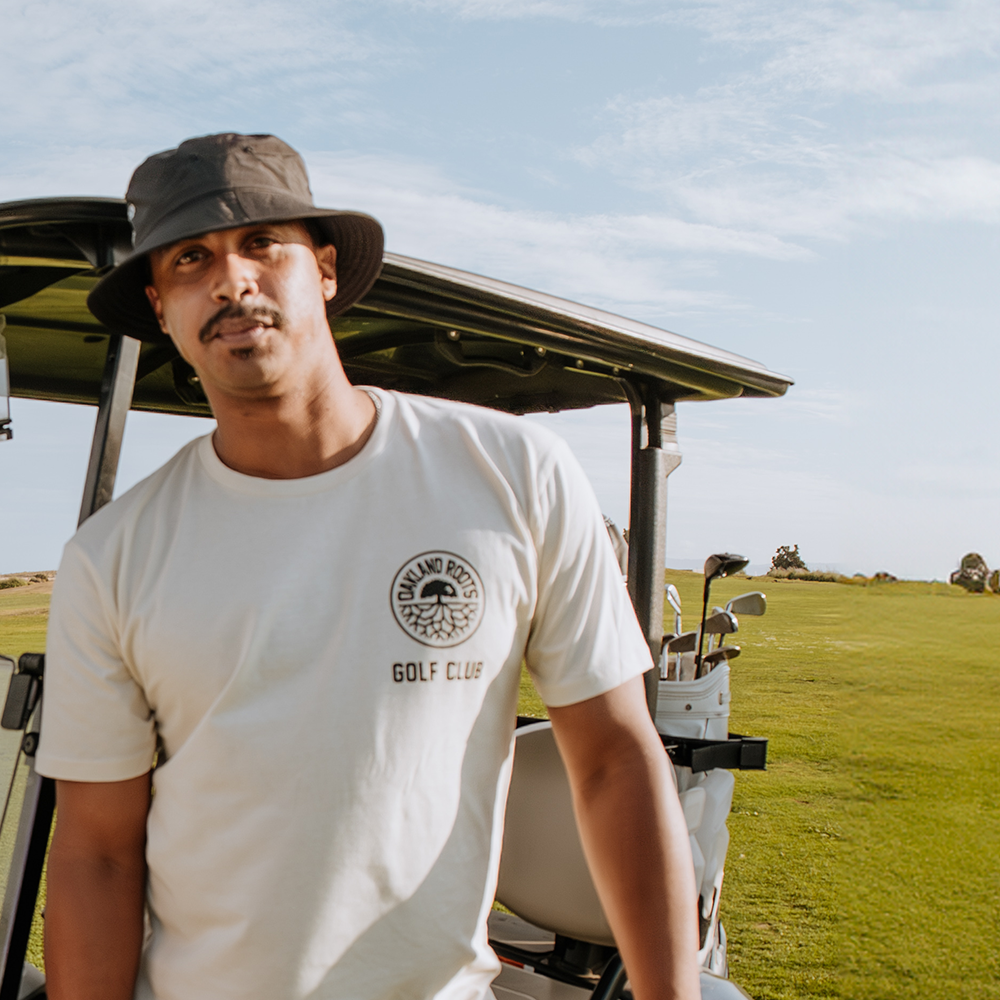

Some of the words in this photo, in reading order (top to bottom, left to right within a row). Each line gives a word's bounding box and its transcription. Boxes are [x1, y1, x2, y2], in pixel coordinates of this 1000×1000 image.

[397, 557, 444, 602] OAKLAND
[445, 559, 479, 599] ROOTS
[392, 661, 438, 683] GOLF
[446, 660, 484, 681] CLUB
